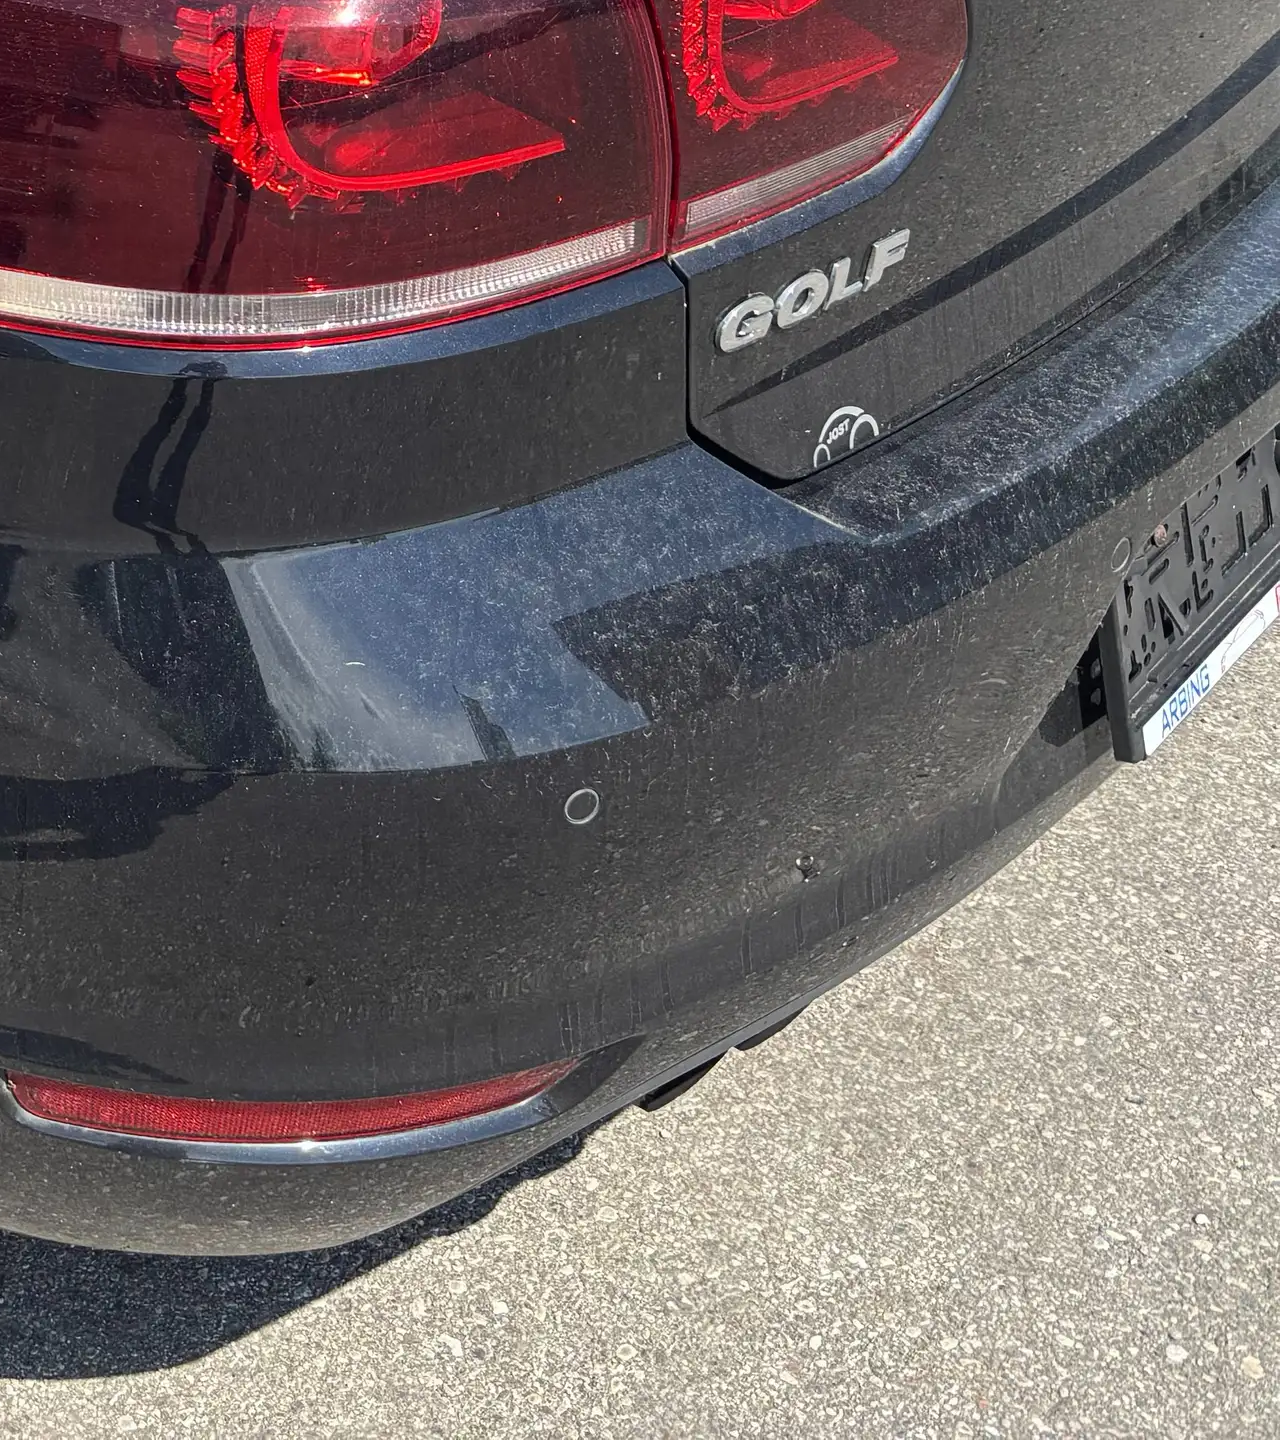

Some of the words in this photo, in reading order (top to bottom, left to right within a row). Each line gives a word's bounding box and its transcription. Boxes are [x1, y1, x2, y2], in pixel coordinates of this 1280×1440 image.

[714, 228, 911, 353] GOLF
[826, 418, 851, 445] JOST
[1161, 663, 1211, 739] ARBING
